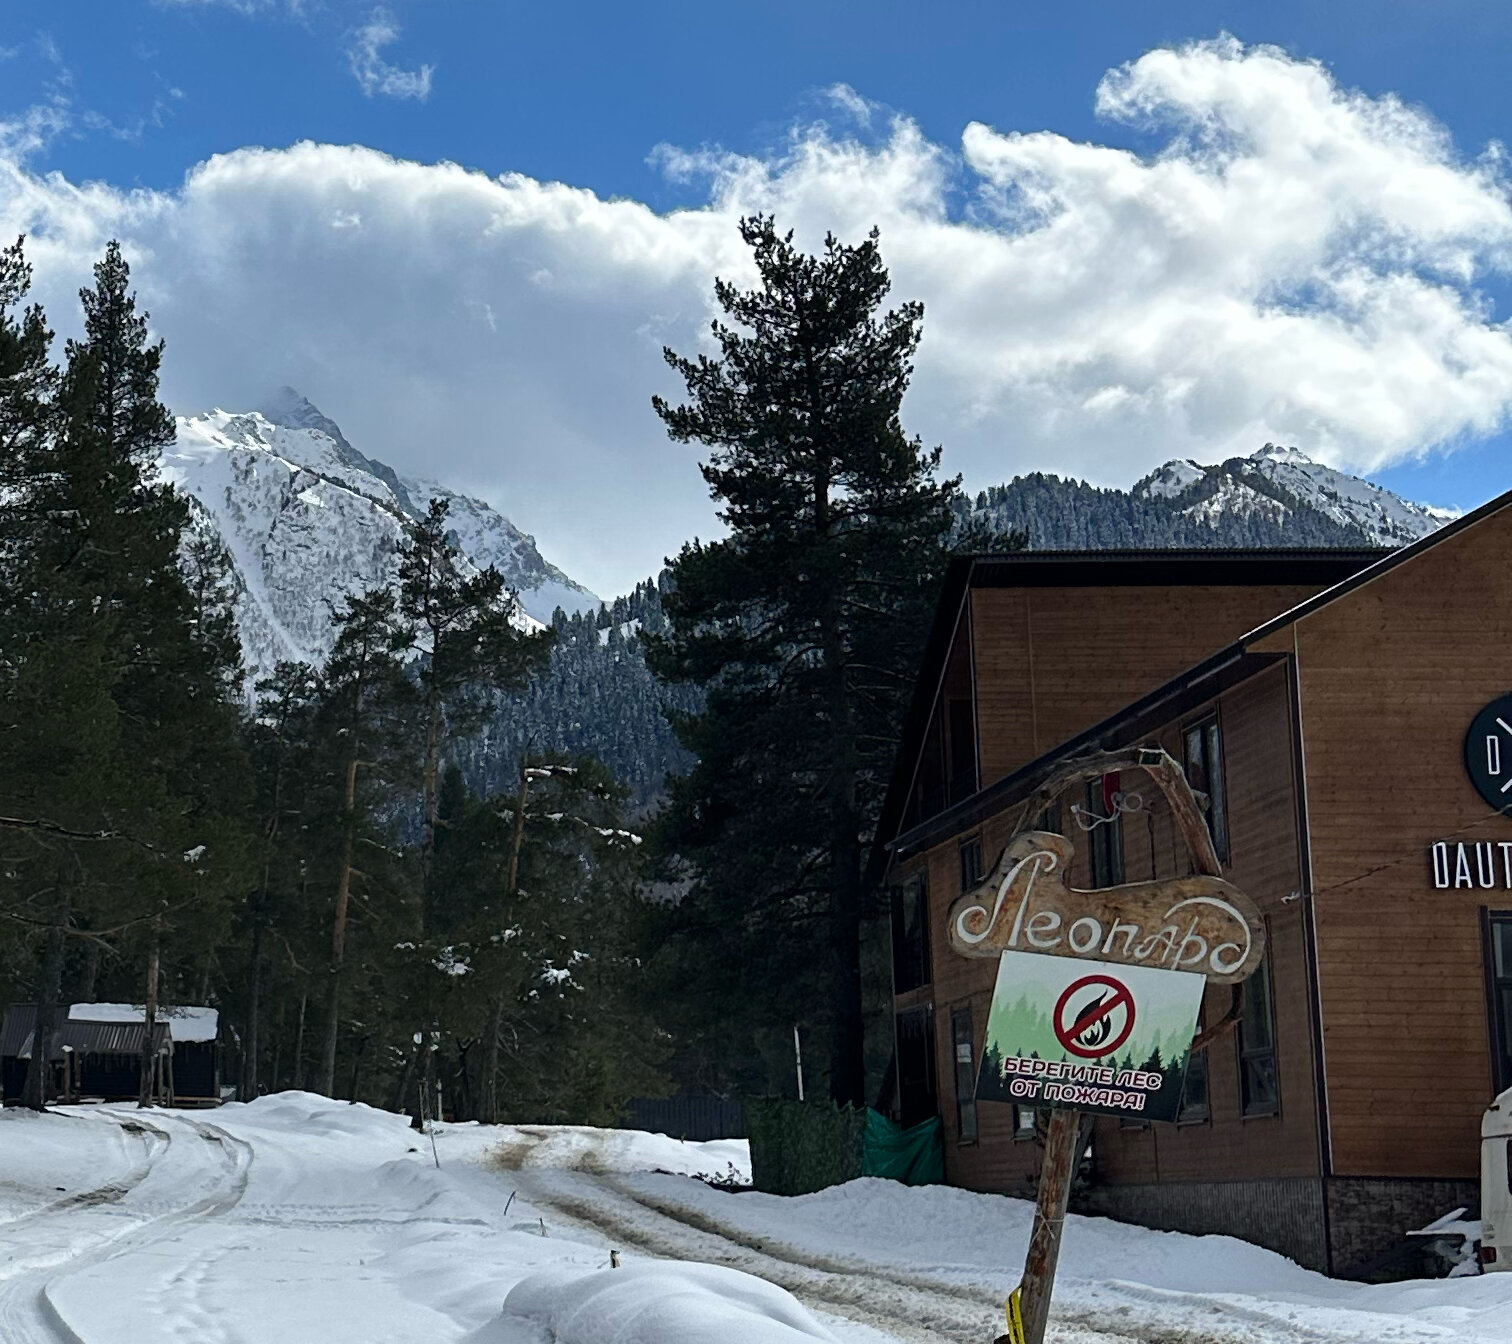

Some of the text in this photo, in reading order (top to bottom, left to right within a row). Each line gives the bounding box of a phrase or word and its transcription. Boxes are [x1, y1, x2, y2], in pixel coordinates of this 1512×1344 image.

[1004, 1057, 1162, 1090] БЕРЕГИТЕ ЛЕС
[1010, 1078, 1146, 1111] ОТ ПОЖАРА!
